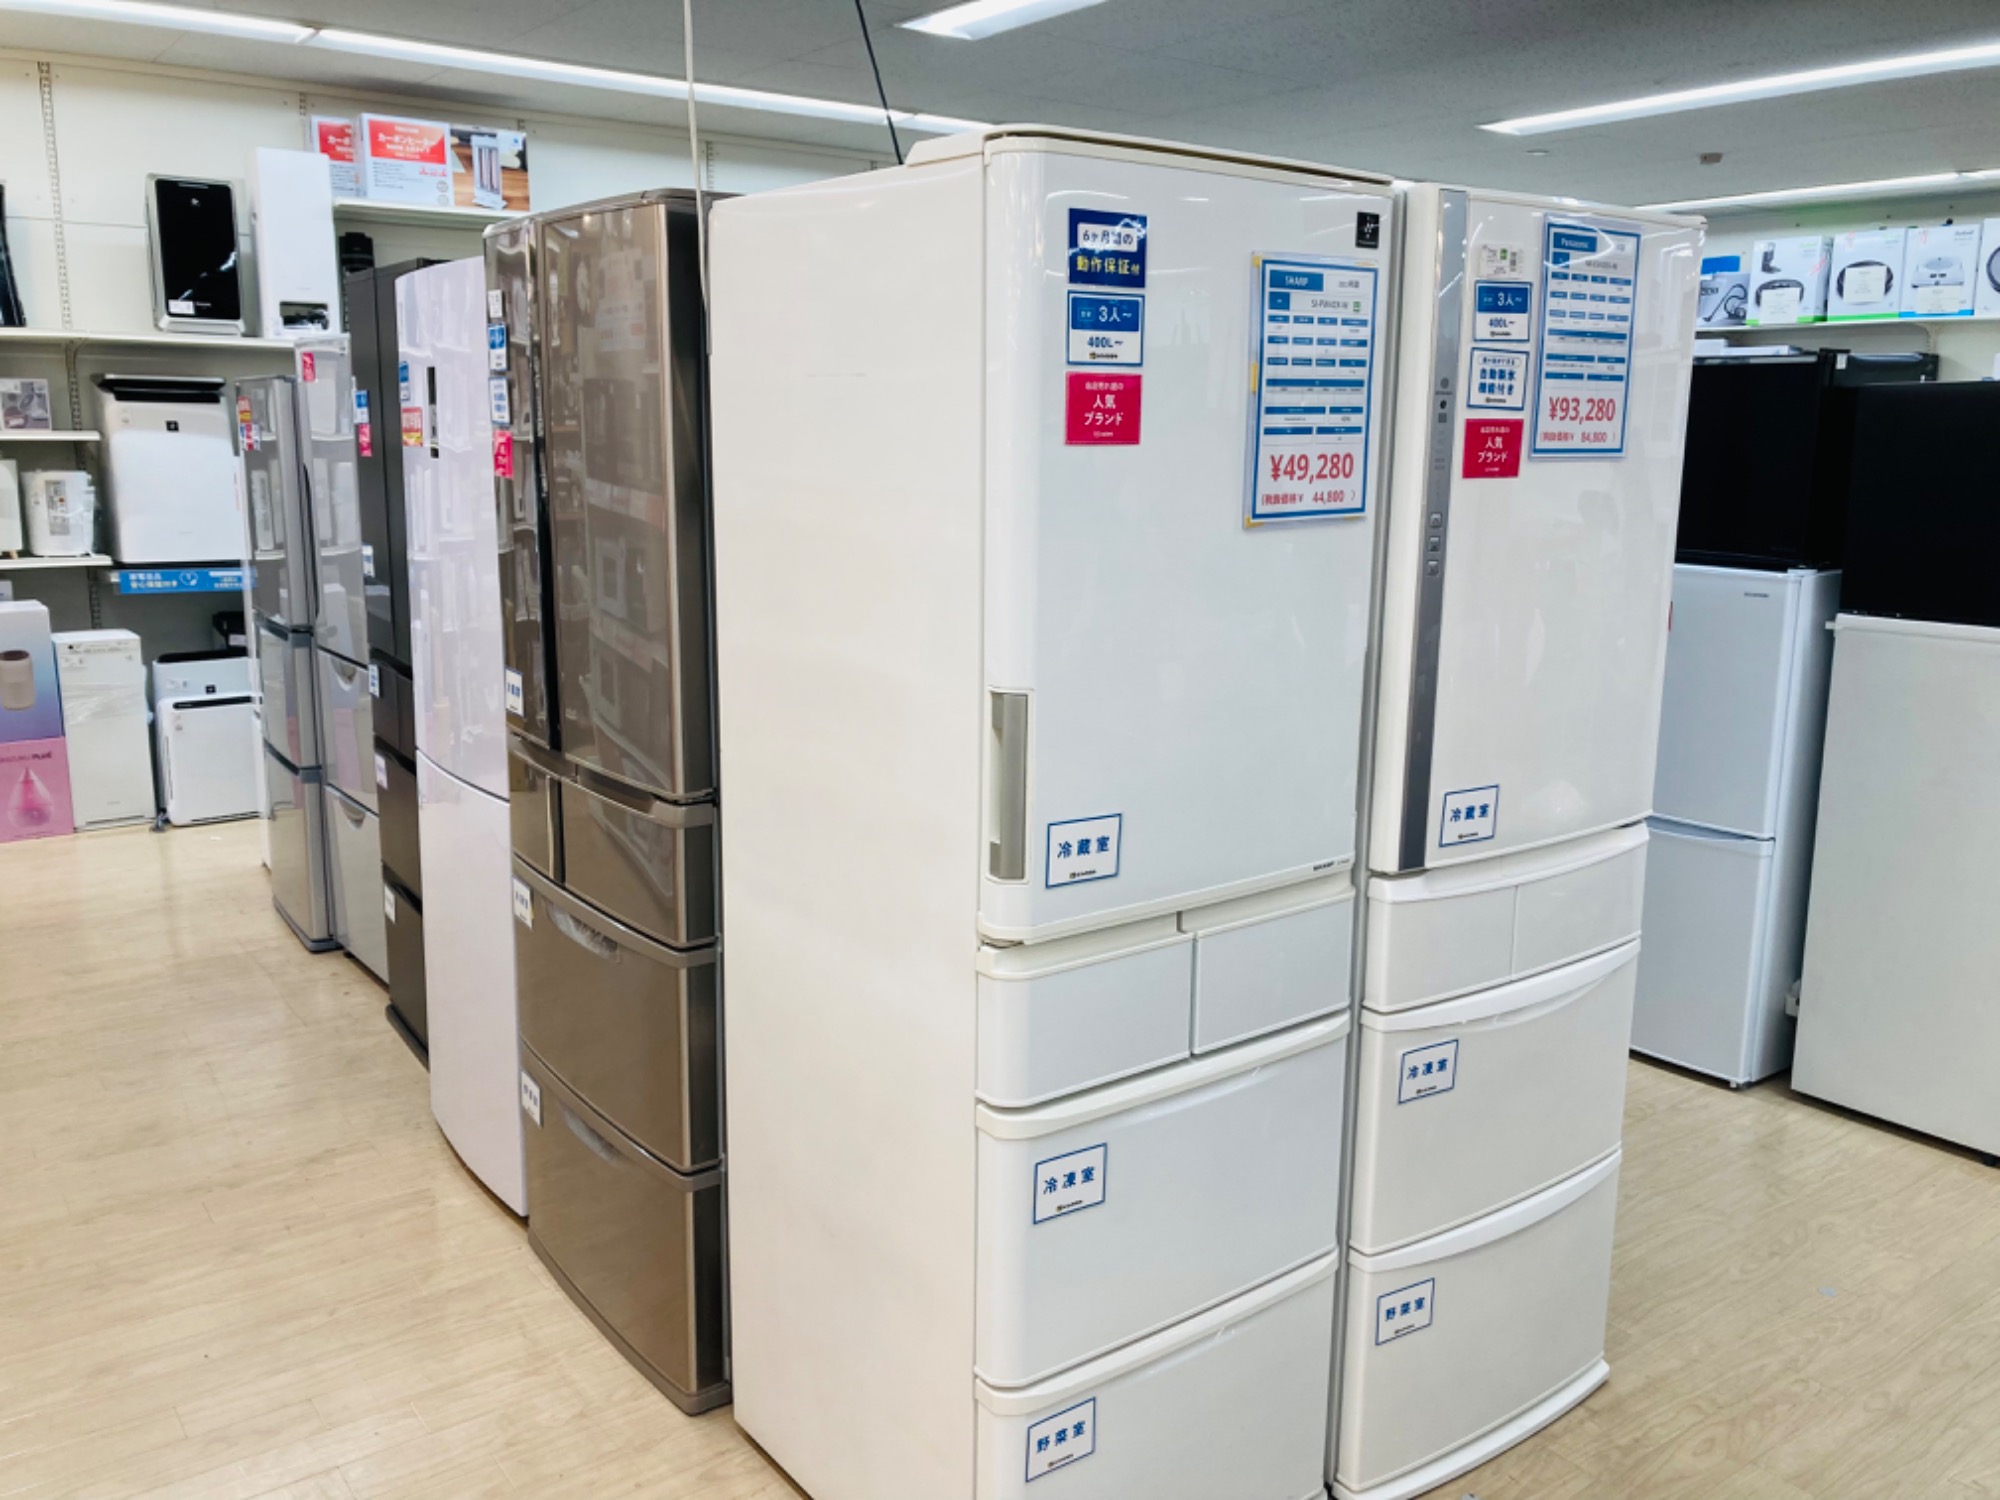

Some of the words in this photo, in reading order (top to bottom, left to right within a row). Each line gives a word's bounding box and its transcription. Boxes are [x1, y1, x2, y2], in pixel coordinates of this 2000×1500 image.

[1092, 394, 1116, 409] 人気
[1548, 396, 1616, 425] ¥93,280
[1084, 411, 1124, 426] ブランド
[1270, 452, 1354, 485] ¥49,280
[1477, 451, 1508, 463] ブランド
[1450, 803, 1490, 822] 冷蔵室
[1057, 835, 1110, 858] 冷蔵室
[1406, 1057, 1448, 1080] 冷凍室
[1043, 1166, 1095, 1195] 冷凍室
[1385, 1296, 1425, 1322] 野菜室
[1036, 1420, 1086, 1454] 野菜室
